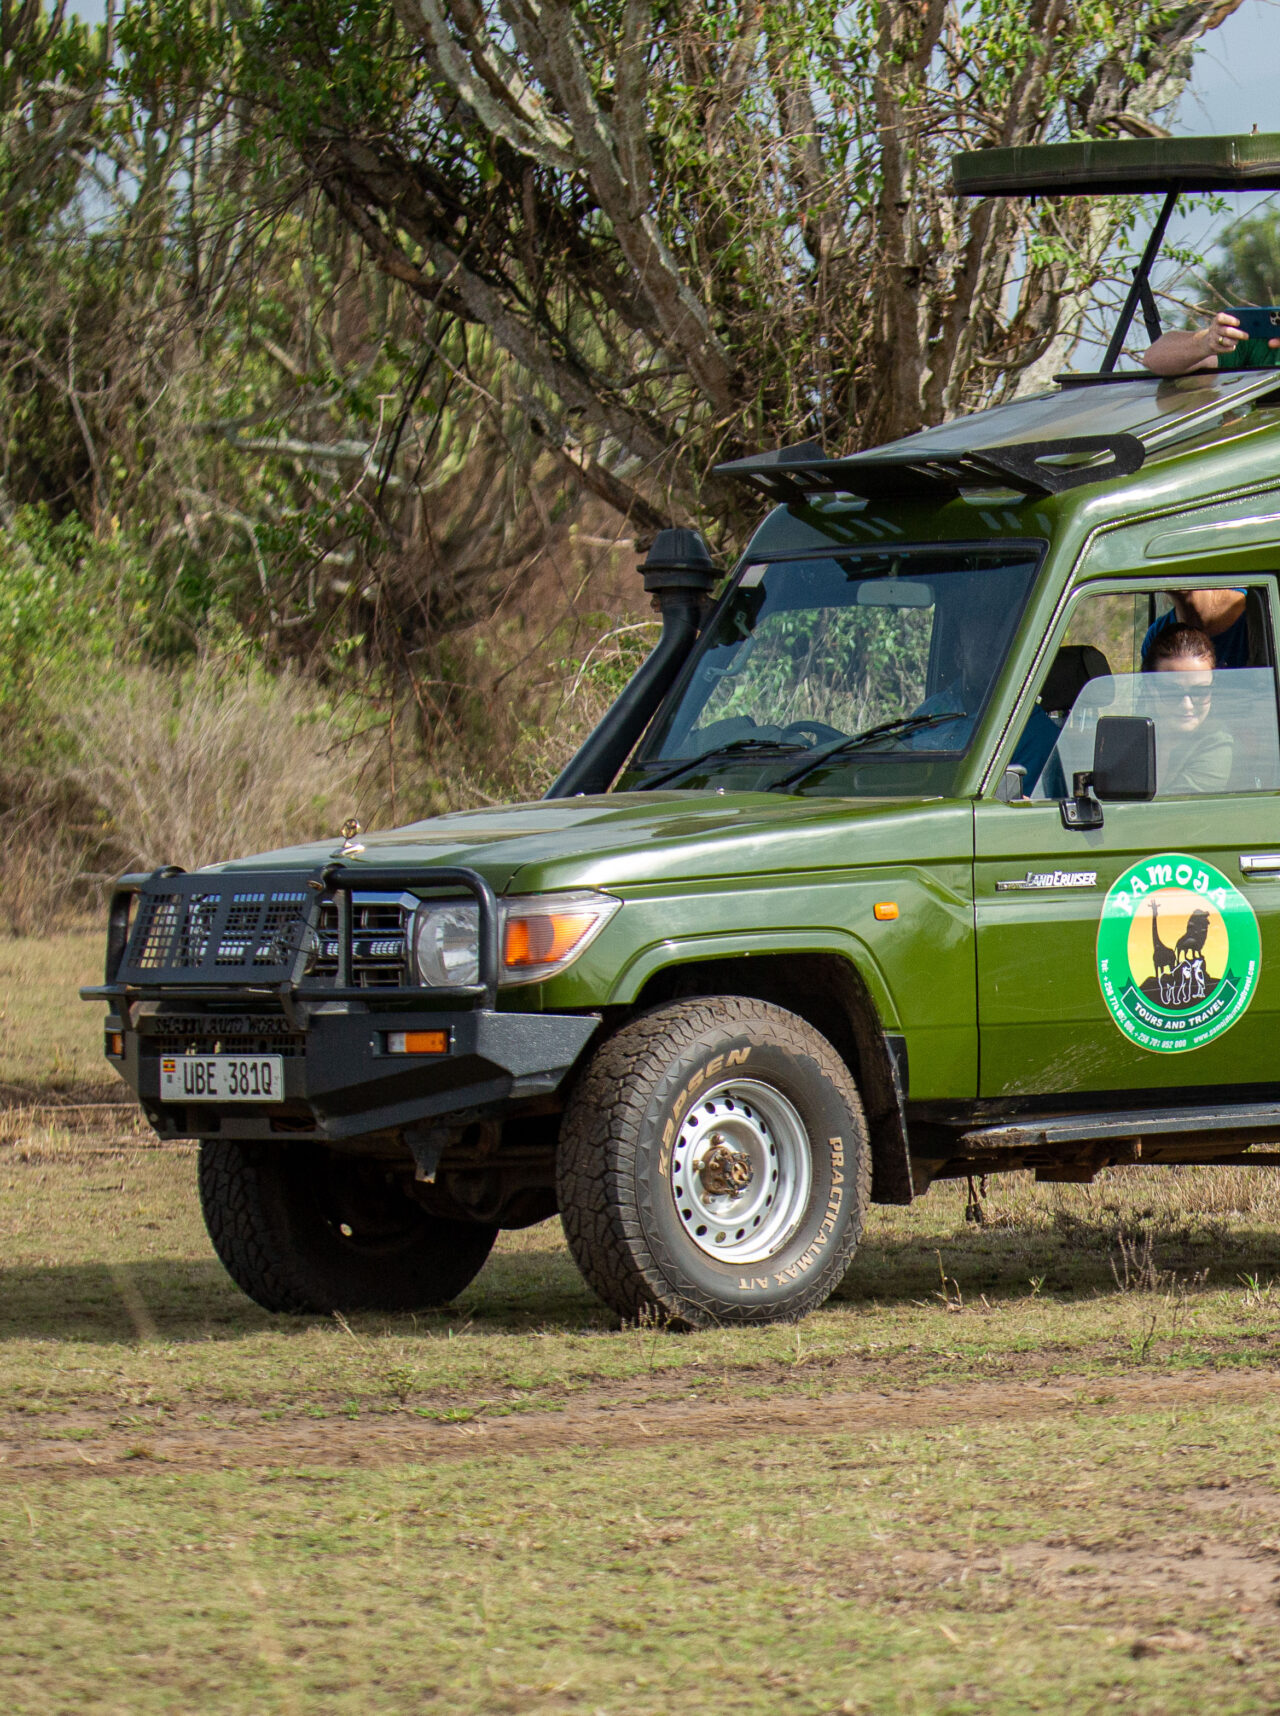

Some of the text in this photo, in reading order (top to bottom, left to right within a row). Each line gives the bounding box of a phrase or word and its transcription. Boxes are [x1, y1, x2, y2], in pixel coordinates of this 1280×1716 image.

[1112, 864, 1227, 916] PAMOJA
[1134, 999, 1225, 1030] TOURS AND TRAVEL
[183, 1062, 273, 1096] UBE 381Q
[658, 1047, 752, 1178] KAPSEN
[738, 1276, 769, 1291] A/T
